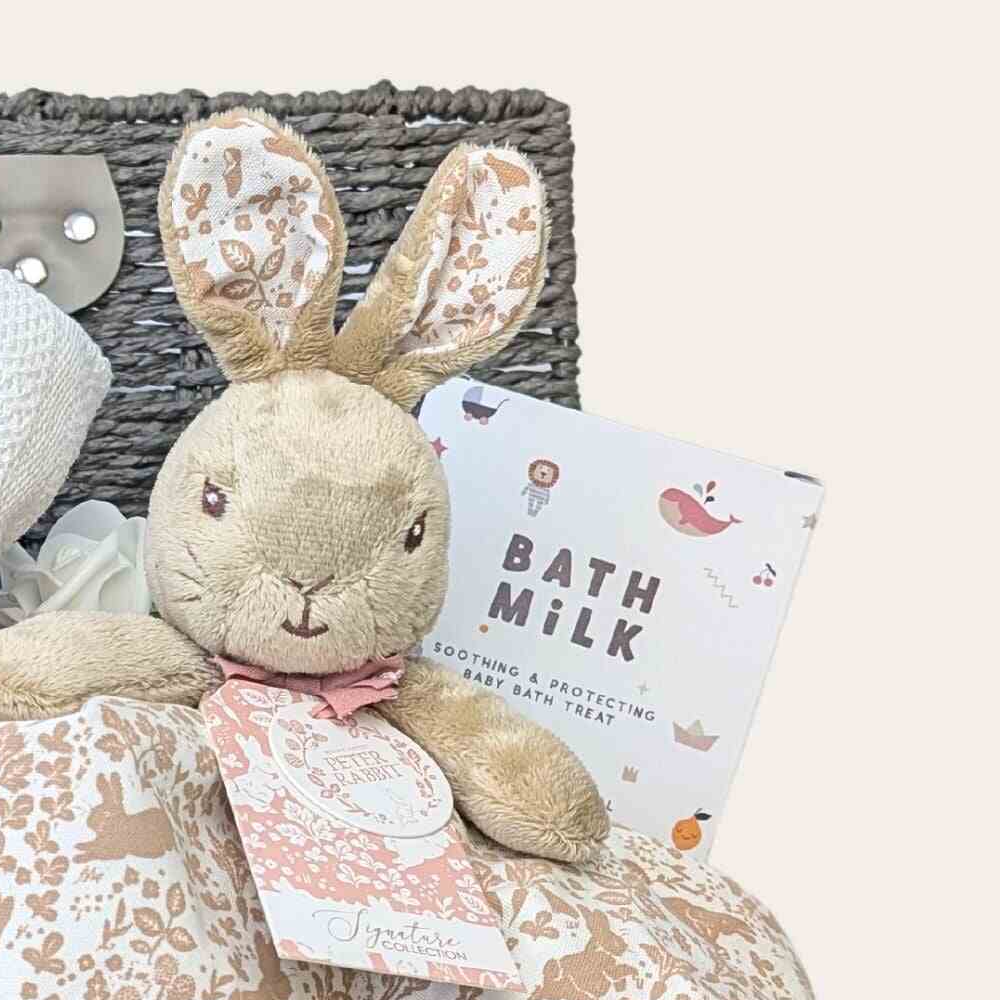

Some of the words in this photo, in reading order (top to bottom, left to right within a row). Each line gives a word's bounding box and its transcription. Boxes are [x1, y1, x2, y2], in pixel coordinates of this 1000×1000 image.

[502, 533, 661, 614] BATH
[432, 641, 520, 678] SOOTHING
[528, 672, 540, 685] &
[549, 678, 657, 722] PROTECTING
[462, 667, 505, 690] BABY
[511, 684, 555, 707] BATH
[564, 700, 616, 727] TREAT
[325, 750, 388, 771] PETER
[334, 764, 404, 785] RABBIT
[312, 908, 462, 949] Signature
[381, 939, 469, 962] COLLECTION
